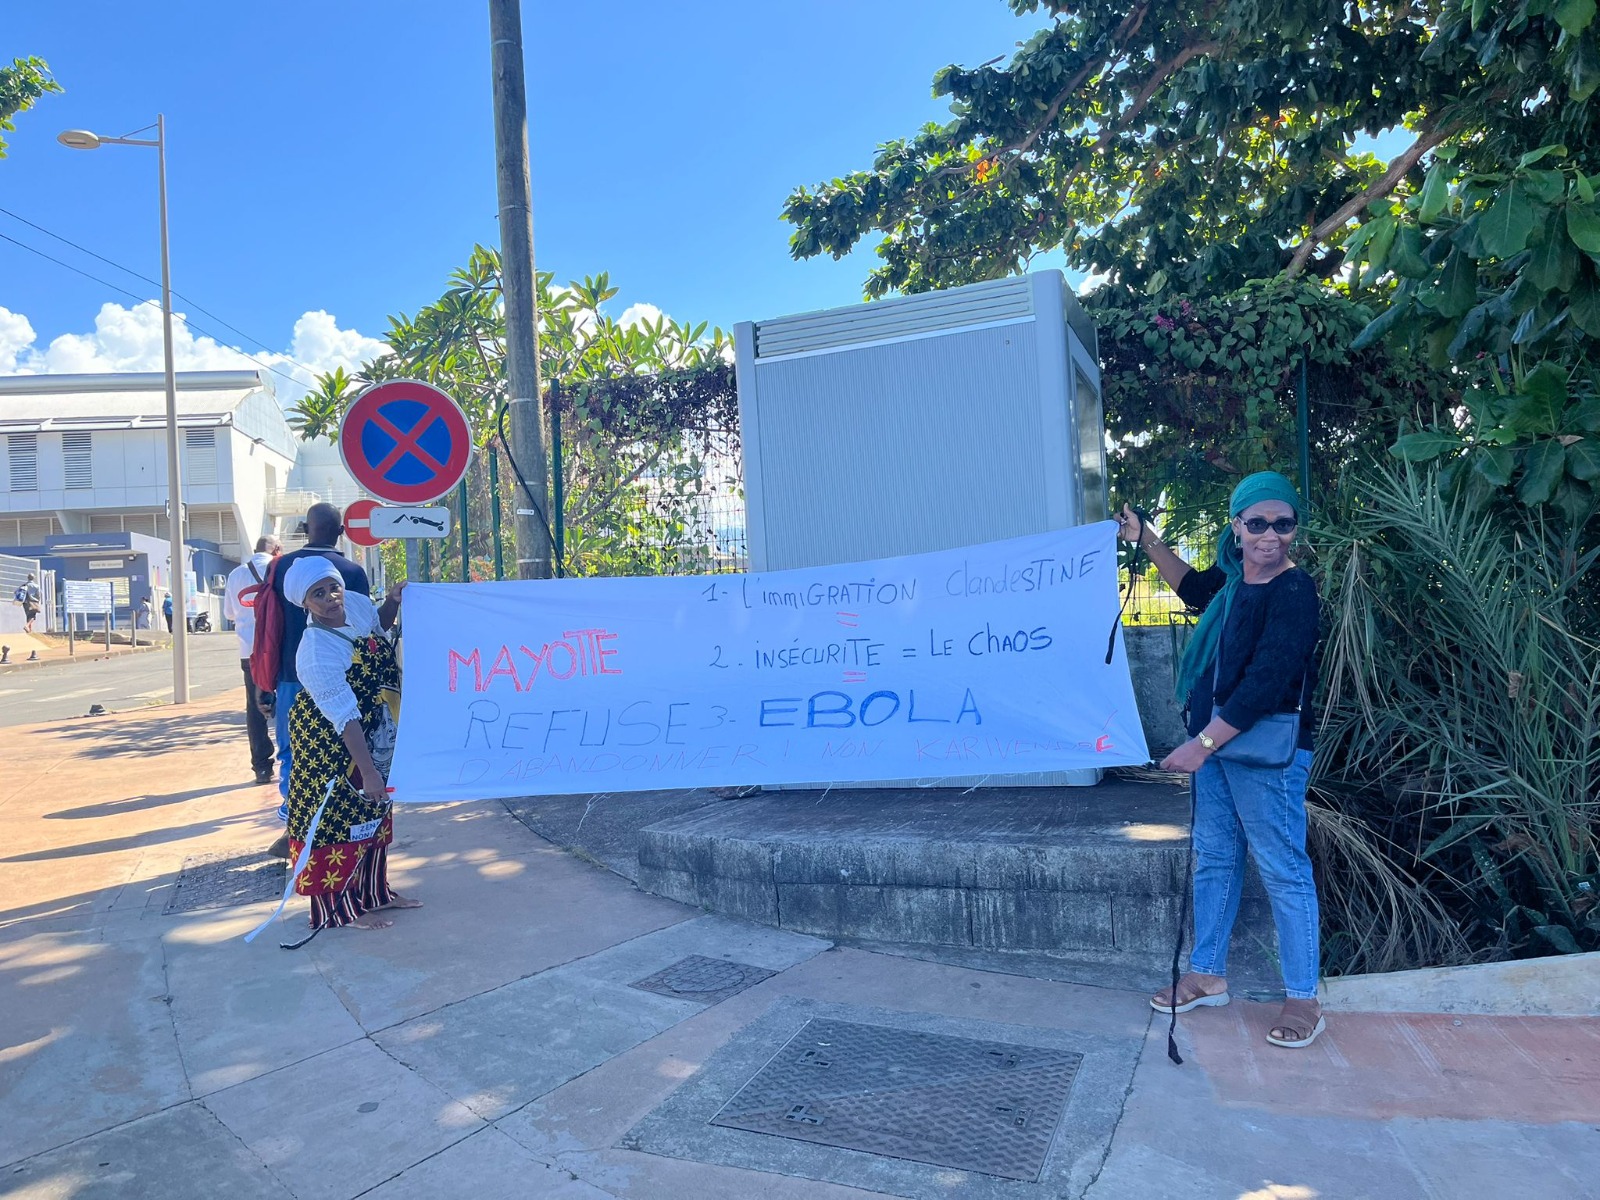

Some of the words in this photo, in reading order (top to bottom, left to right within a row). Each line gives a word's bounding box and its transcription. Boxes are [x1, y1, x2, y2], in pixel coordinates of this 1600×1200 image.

[448, 628, 623, 692] MAYOTTE
[930, 628, 954, 657] LE
[464, 699, 691, 752] REFUSE
[759, 687, 982, 730] EBOLA
[821, 738, 884, 759] NON
